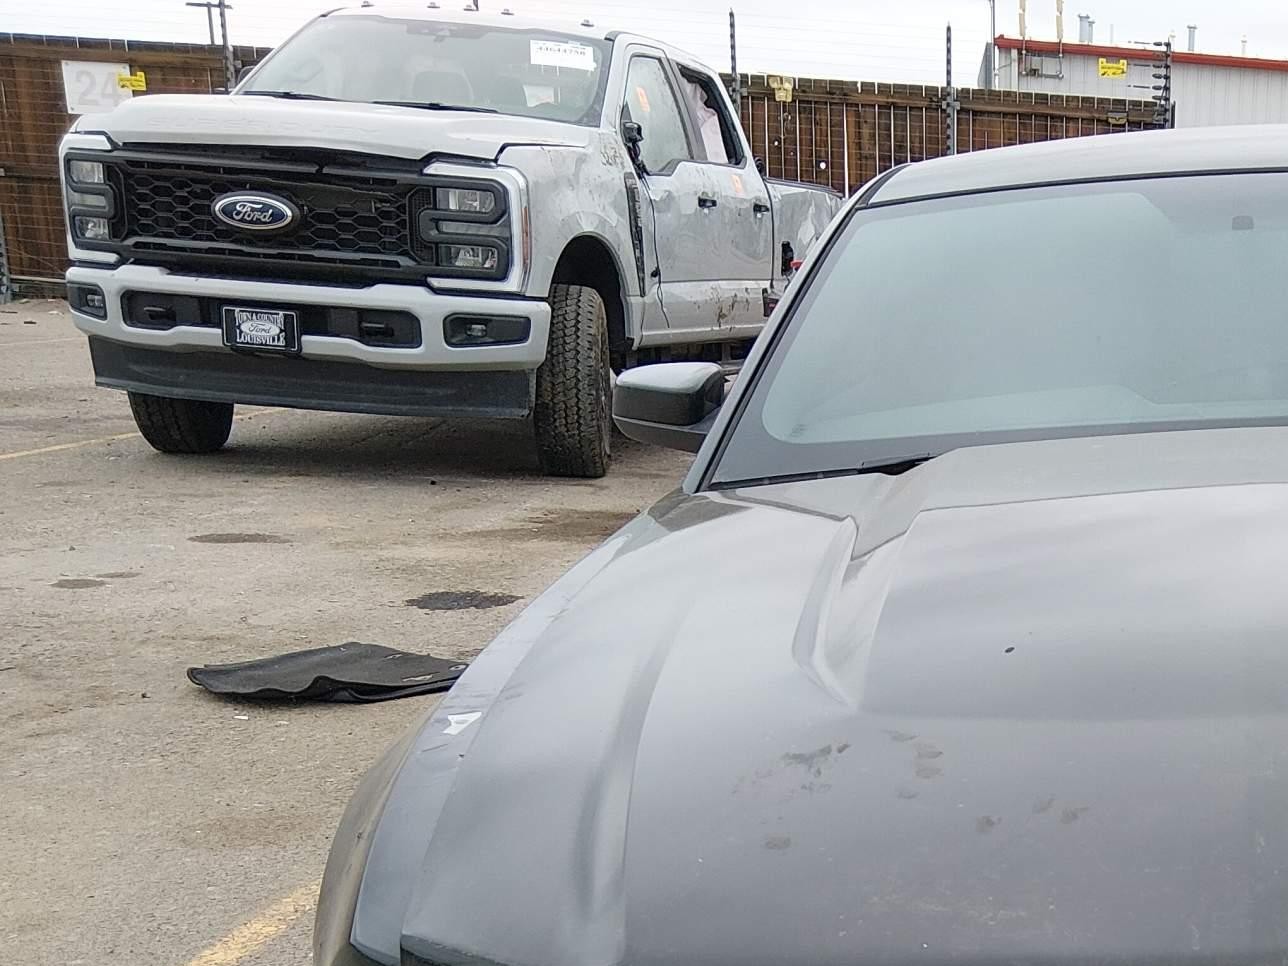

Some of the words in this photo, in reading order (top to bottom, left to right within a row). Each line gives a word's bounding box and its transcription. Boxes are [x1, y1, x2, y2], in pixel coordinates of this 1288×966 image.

[75, 70, 121, 107] 24
[232, 202, 273, 222] Ford
[249, 323, 271, 333] Ford
[235, 329, 286, 346] LOUISVILLE
